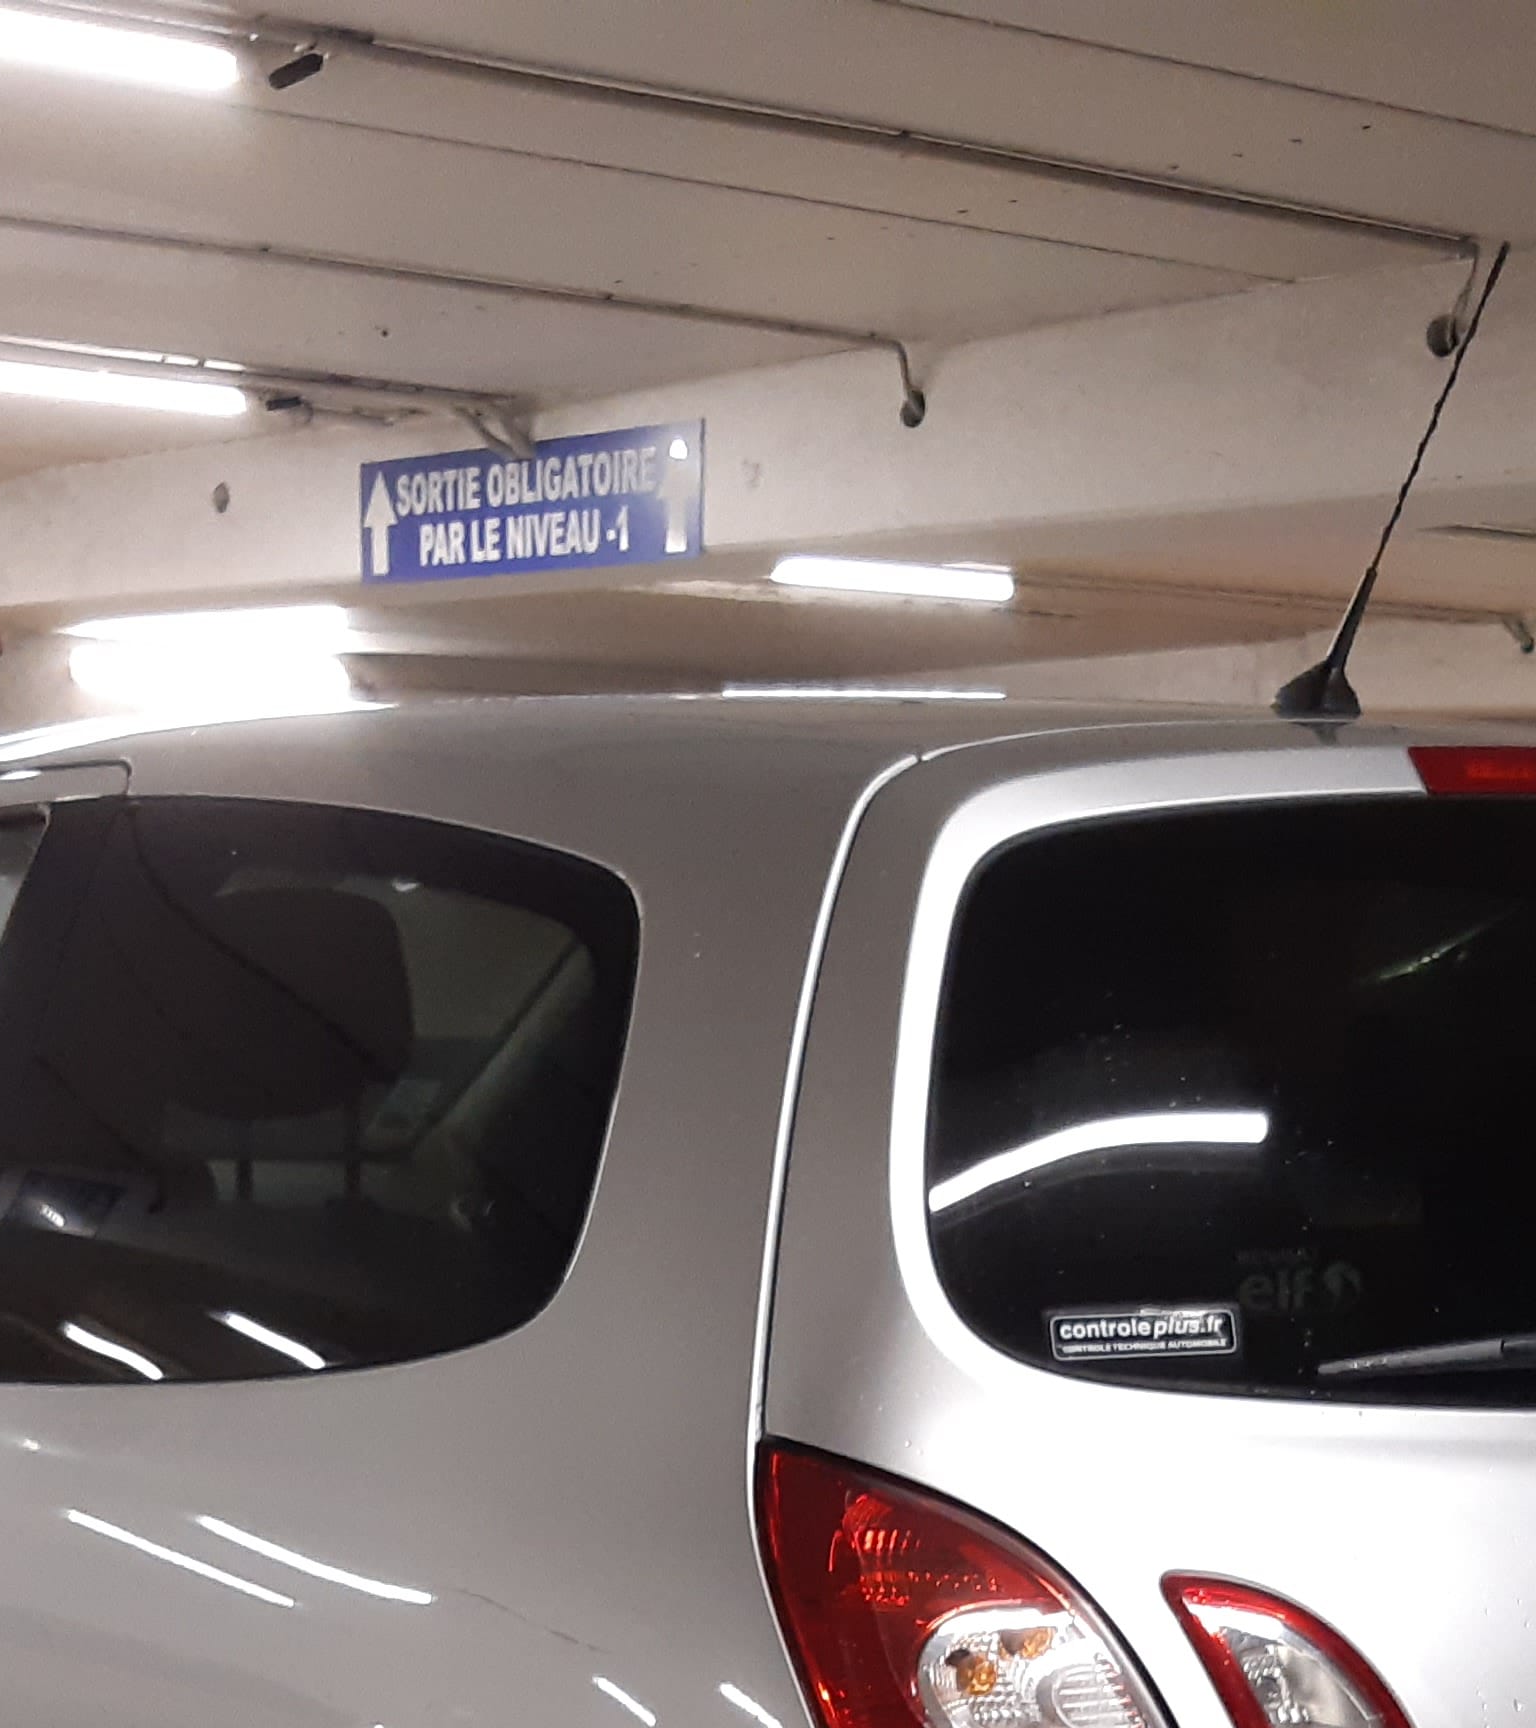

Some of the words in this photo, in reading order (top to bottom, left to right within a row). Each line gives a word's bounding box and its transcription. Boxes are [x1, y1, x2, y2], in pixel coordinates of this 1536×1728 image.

[395, 466, 482, 517] SORTIE
[486, 446, 657, 508] OBLIGATOIRE
[419, 522, 466, 567] PAR
[471, 517, 502, 563] LE
[506, 509, 600, 560] NIVEAU
[606, 504, 630, 552] -1
